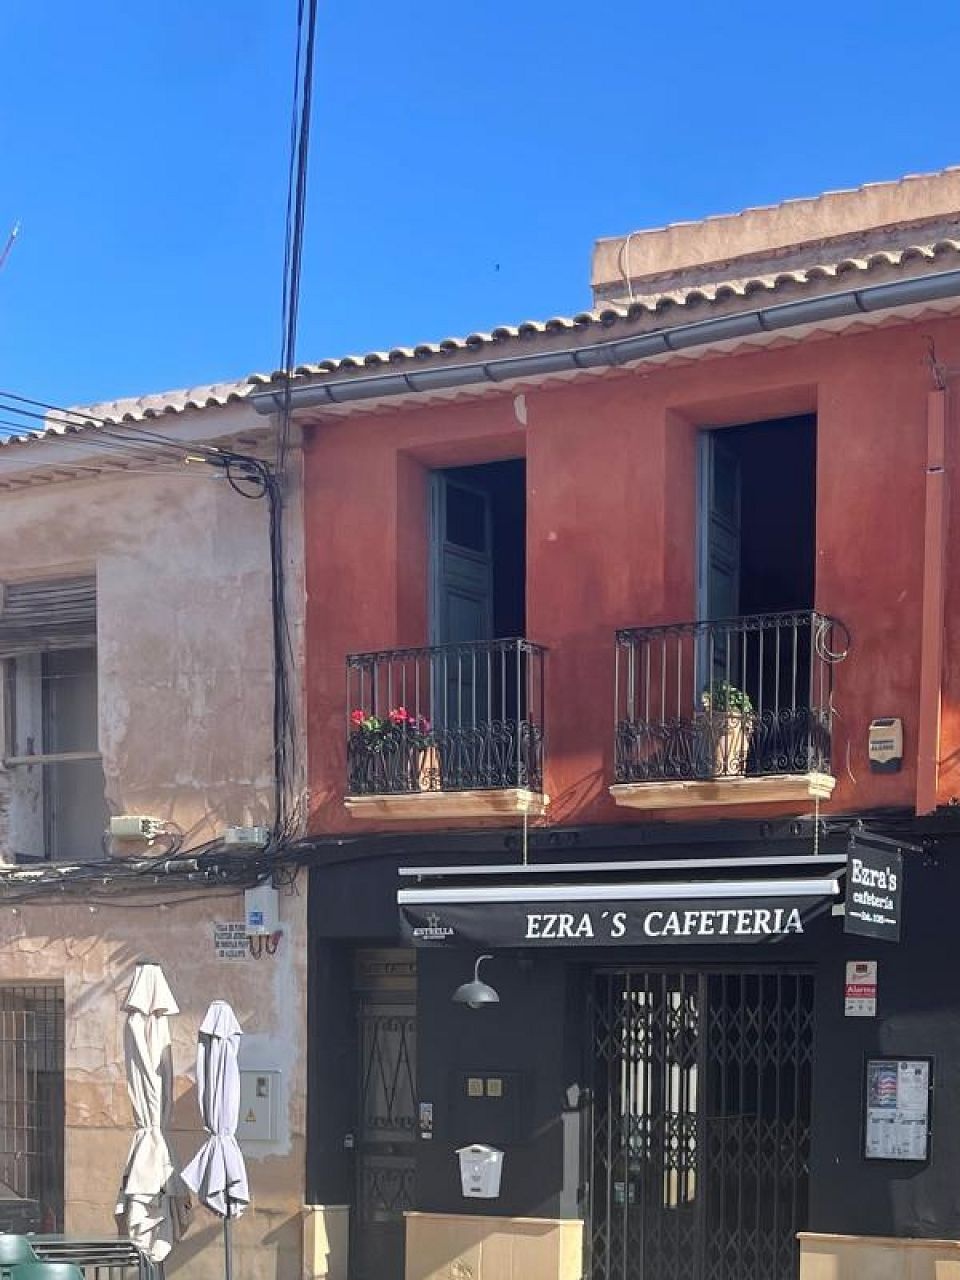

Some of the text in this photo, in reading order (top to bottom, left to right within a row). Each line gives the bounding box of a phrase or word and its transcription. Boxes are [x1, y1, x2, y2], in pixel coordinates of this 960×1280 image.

[852, 858, 897, 892] Ezra's
[525, 913, 594, 938] EZRA
[644, 908, 804, 936] CAFETERIA
